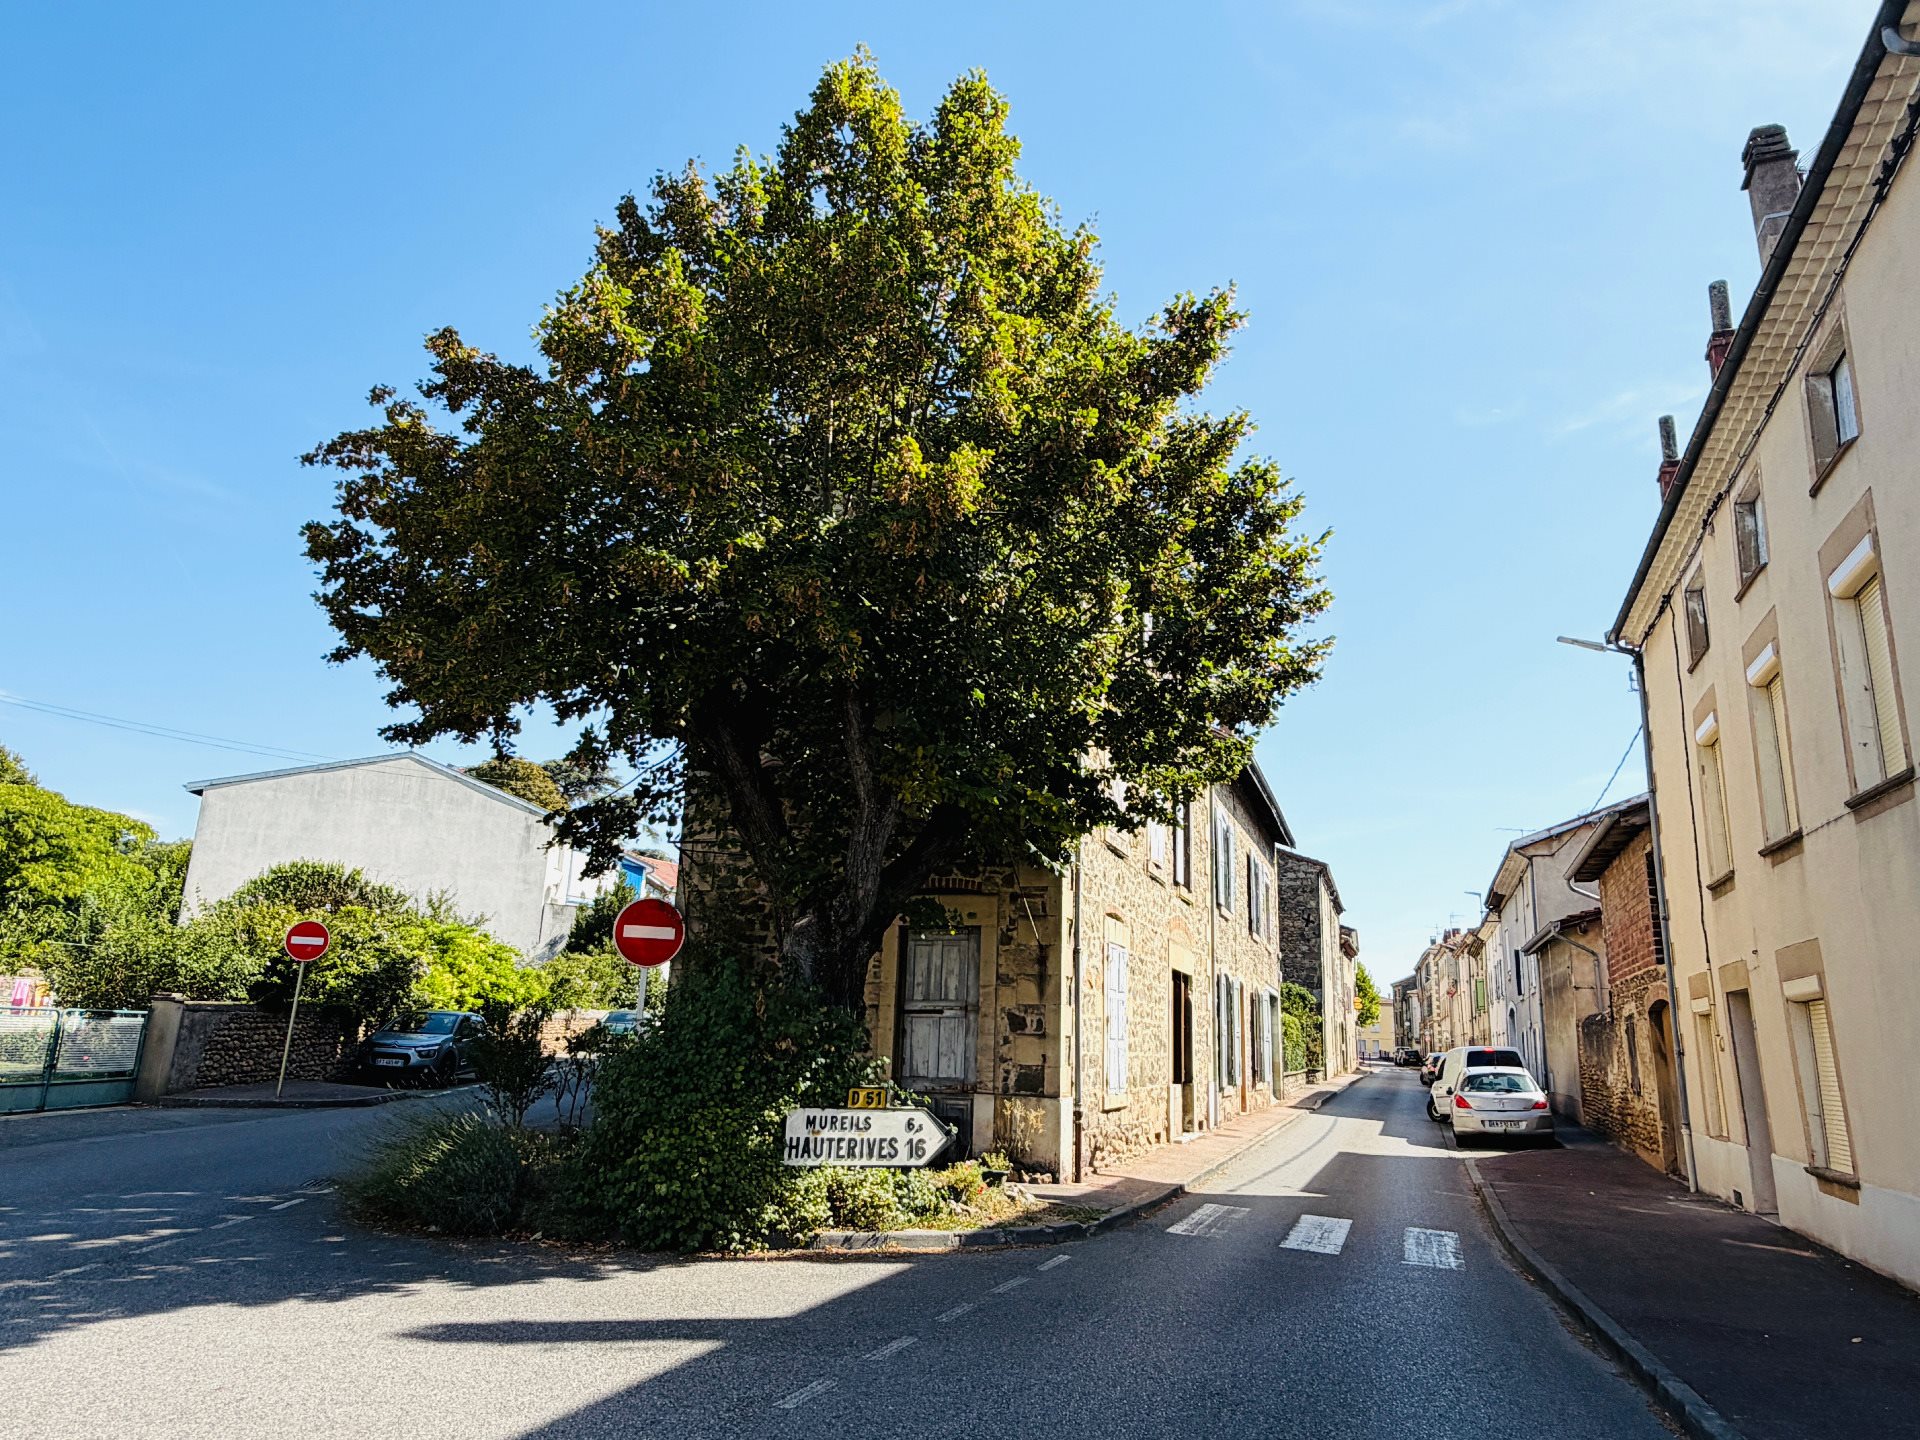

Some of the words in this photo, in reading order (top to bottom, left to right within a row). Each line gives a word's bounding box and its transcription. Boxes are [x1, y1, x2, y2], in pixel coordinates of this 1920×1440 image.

[851, 1090, 860, 1106] D
[866, 1091, 882, 1106] 51
[806, 1115, 872, 1131] MUREILS
[787, 1137, 899, 1160] HAUTERIVES
[905, 1137, 926, 1160] 16
